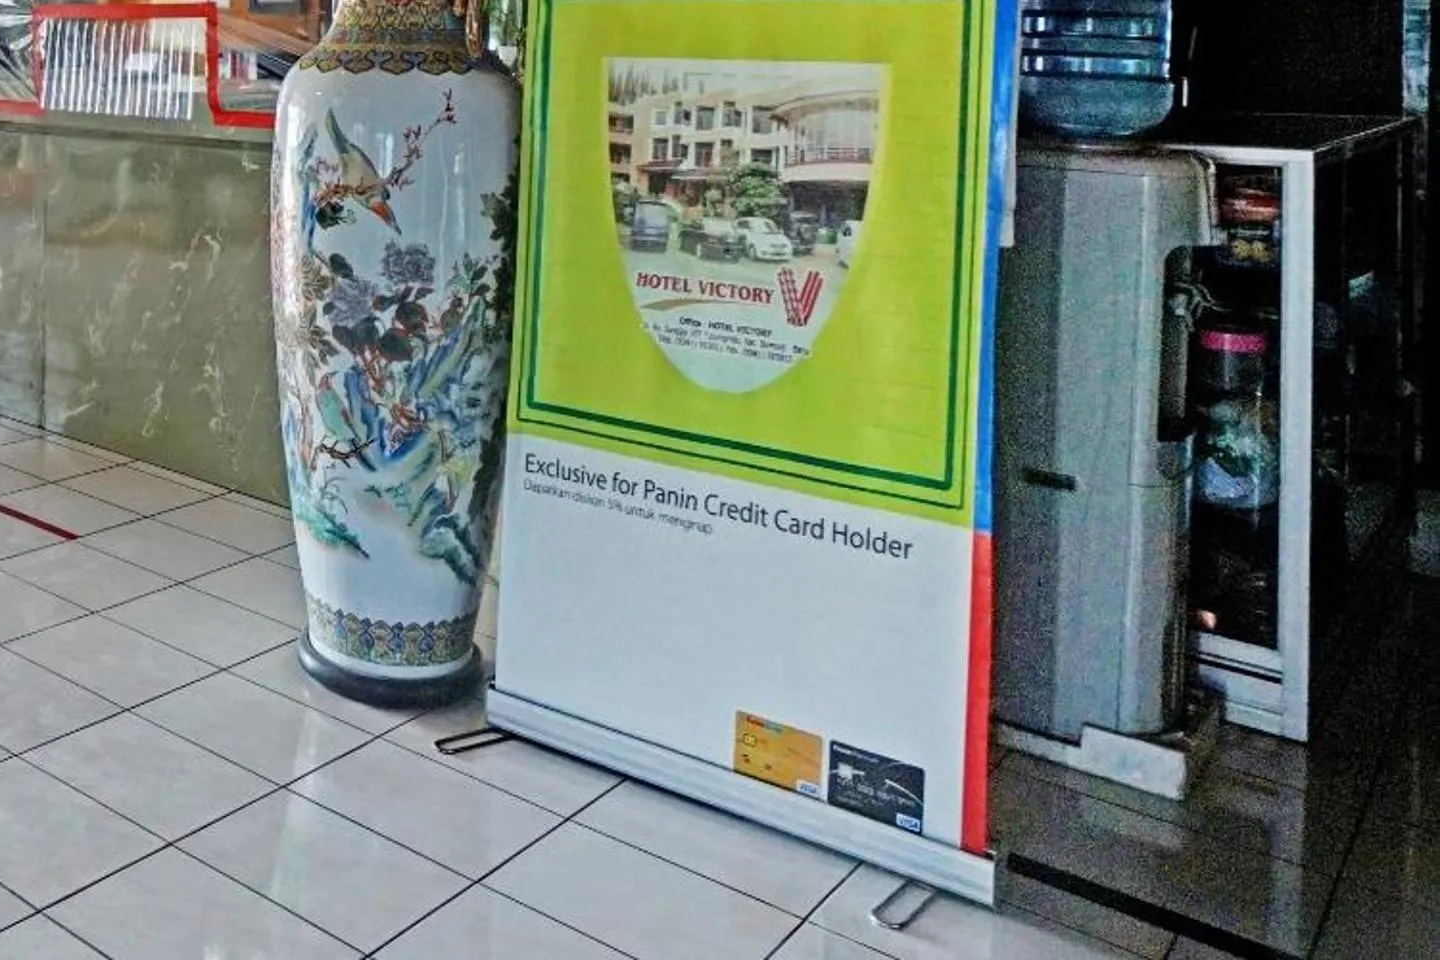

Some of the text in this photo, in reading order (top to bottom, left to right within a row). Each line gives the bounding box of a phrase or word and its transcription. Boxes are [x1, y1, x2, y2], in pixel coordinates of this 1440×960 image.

[636, 272, 776, 304] HOTEL VICTORY
[524, 452, 914, 559] Exclusive for Panin Credit Card Holder
[624, 503, 655, 520] untuk
